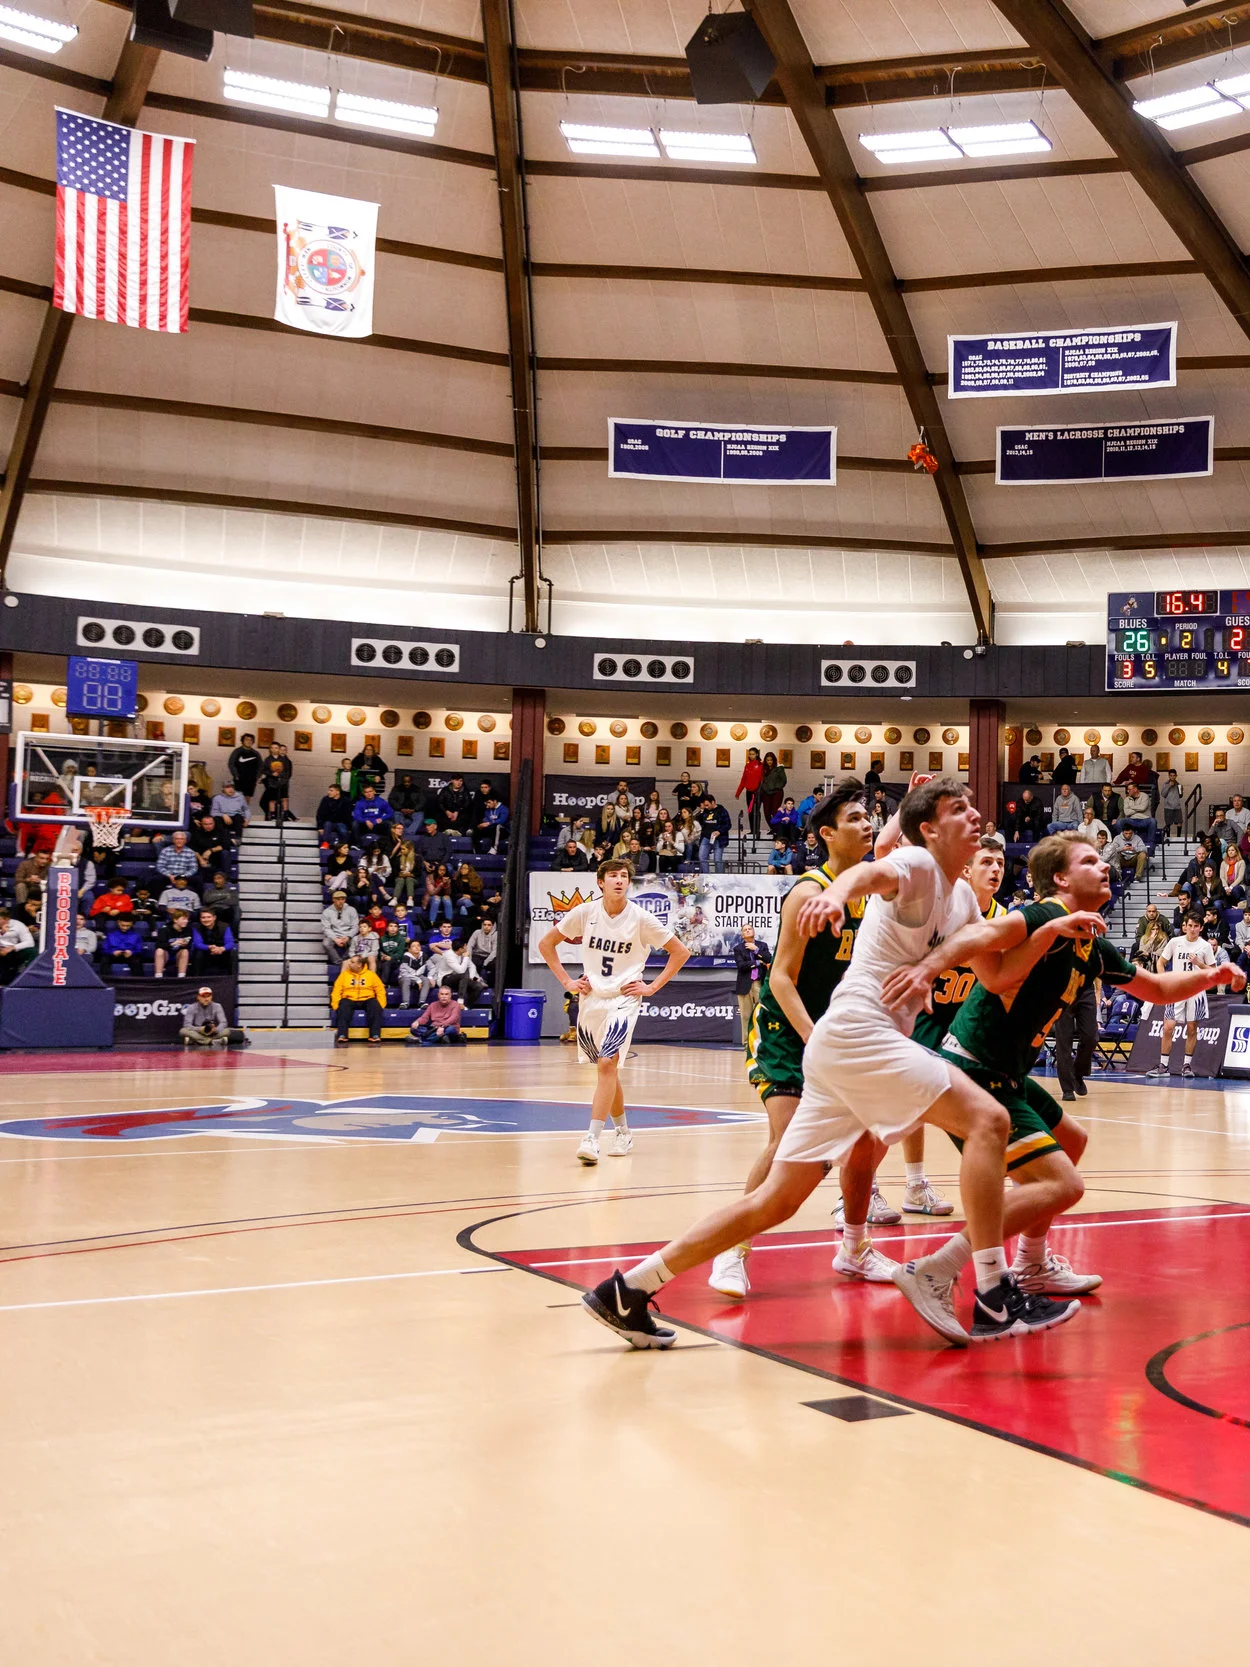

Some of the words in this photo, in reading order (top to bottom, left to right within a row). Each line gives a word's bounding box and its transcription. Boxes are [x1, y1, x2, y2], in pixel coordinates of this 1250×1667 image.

[987, 339, 1045, 350] BASEBALL
[1049, 333, 1141, 347] CHAMPIONSHIPS
[656, 429, 686, 438] GOLF
[689, 430, 787, 442] CHAMPIONSHIPS
[1025, 432, 1054, 440] MEN'S
[1057, 430, 1104, 439] LACROSSE
[1108, 425, 1185, 437] CHAMPIONSHIPS
[1119, 618, 1147, 629] BLUES
[1175, 622, 1198, 630] PERIOD
[1123, 631, 1149, 651] 26
[1181, 632, 1191, 648] 2
[1141, 653, 1158, 661] T.O.L.
[1191, 652, 1207, 660] FOUL
[1123, 662, 1132, 678] 3
[1145, 661, 1155, 677] 5
[1217, 662, 1228, 675] 4
[715, 895, 784, 914] OPPORTU
[53, 872, 71, 985] BROOKDALE
[715, 916, 745, 928] START
[752, 916, 772, 928] HERE
[589, 936, 633, 954] EAGLES
[601, 957, 613, 977] 5
[1183, 962, 1193, 971] 13
[934, 969, 976, 1004] 30
